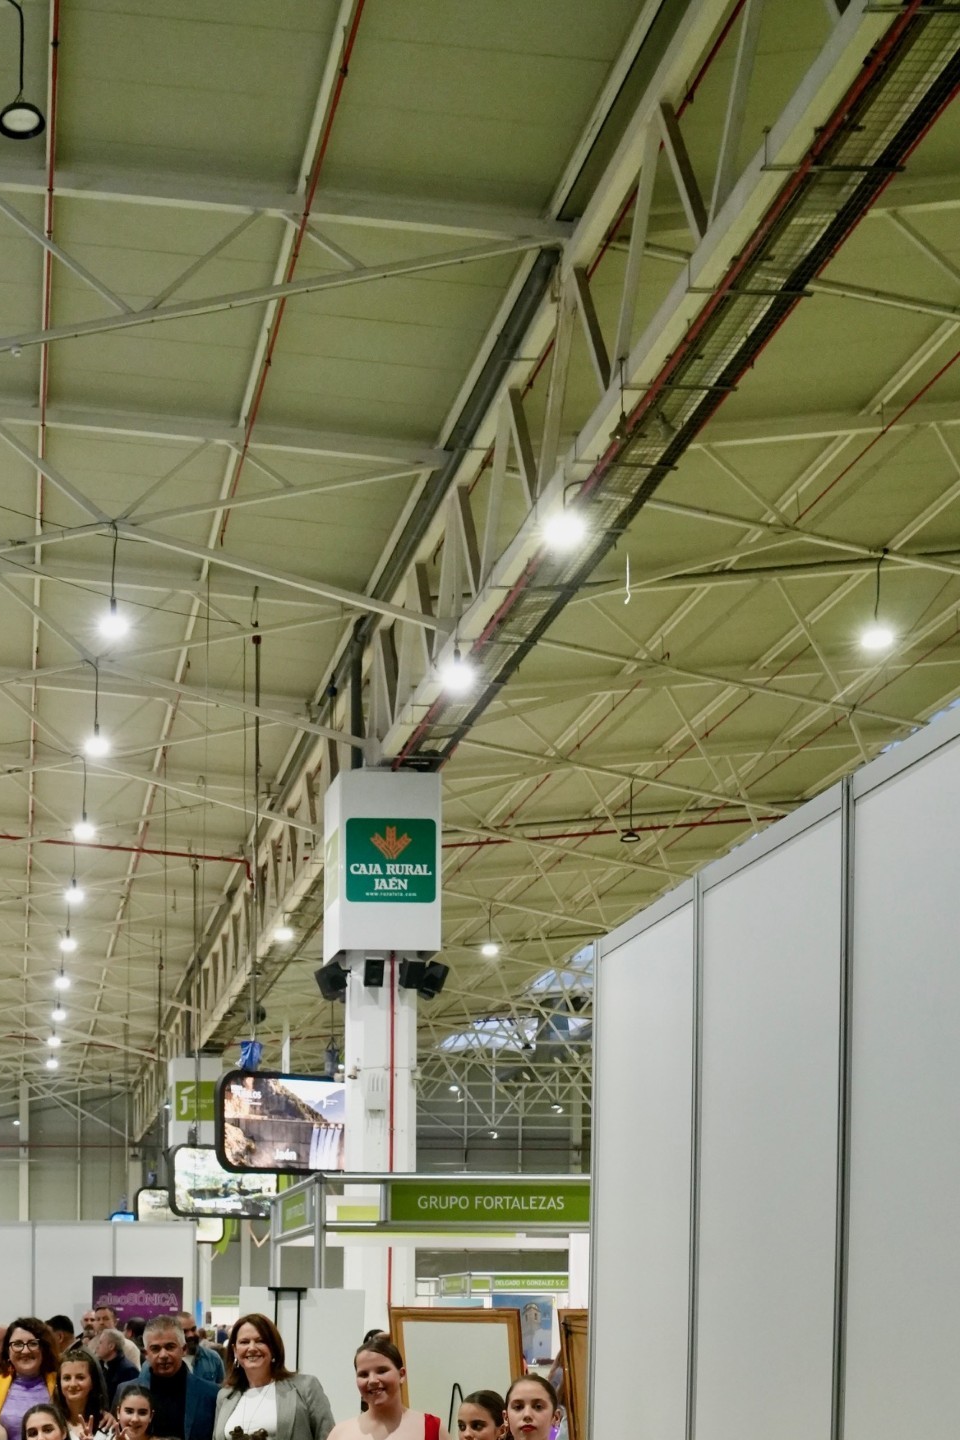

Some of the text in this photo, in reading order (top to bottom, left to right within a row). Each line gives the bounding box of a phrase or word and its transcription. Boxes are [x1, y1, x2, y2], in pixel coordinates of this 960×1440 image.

[350, 863, 432, 876] CAJA RURAL
[374, 876, 408, 891] JAÉN
[417, 1195, 565, 1211] GRUPO FORTALEZAS
